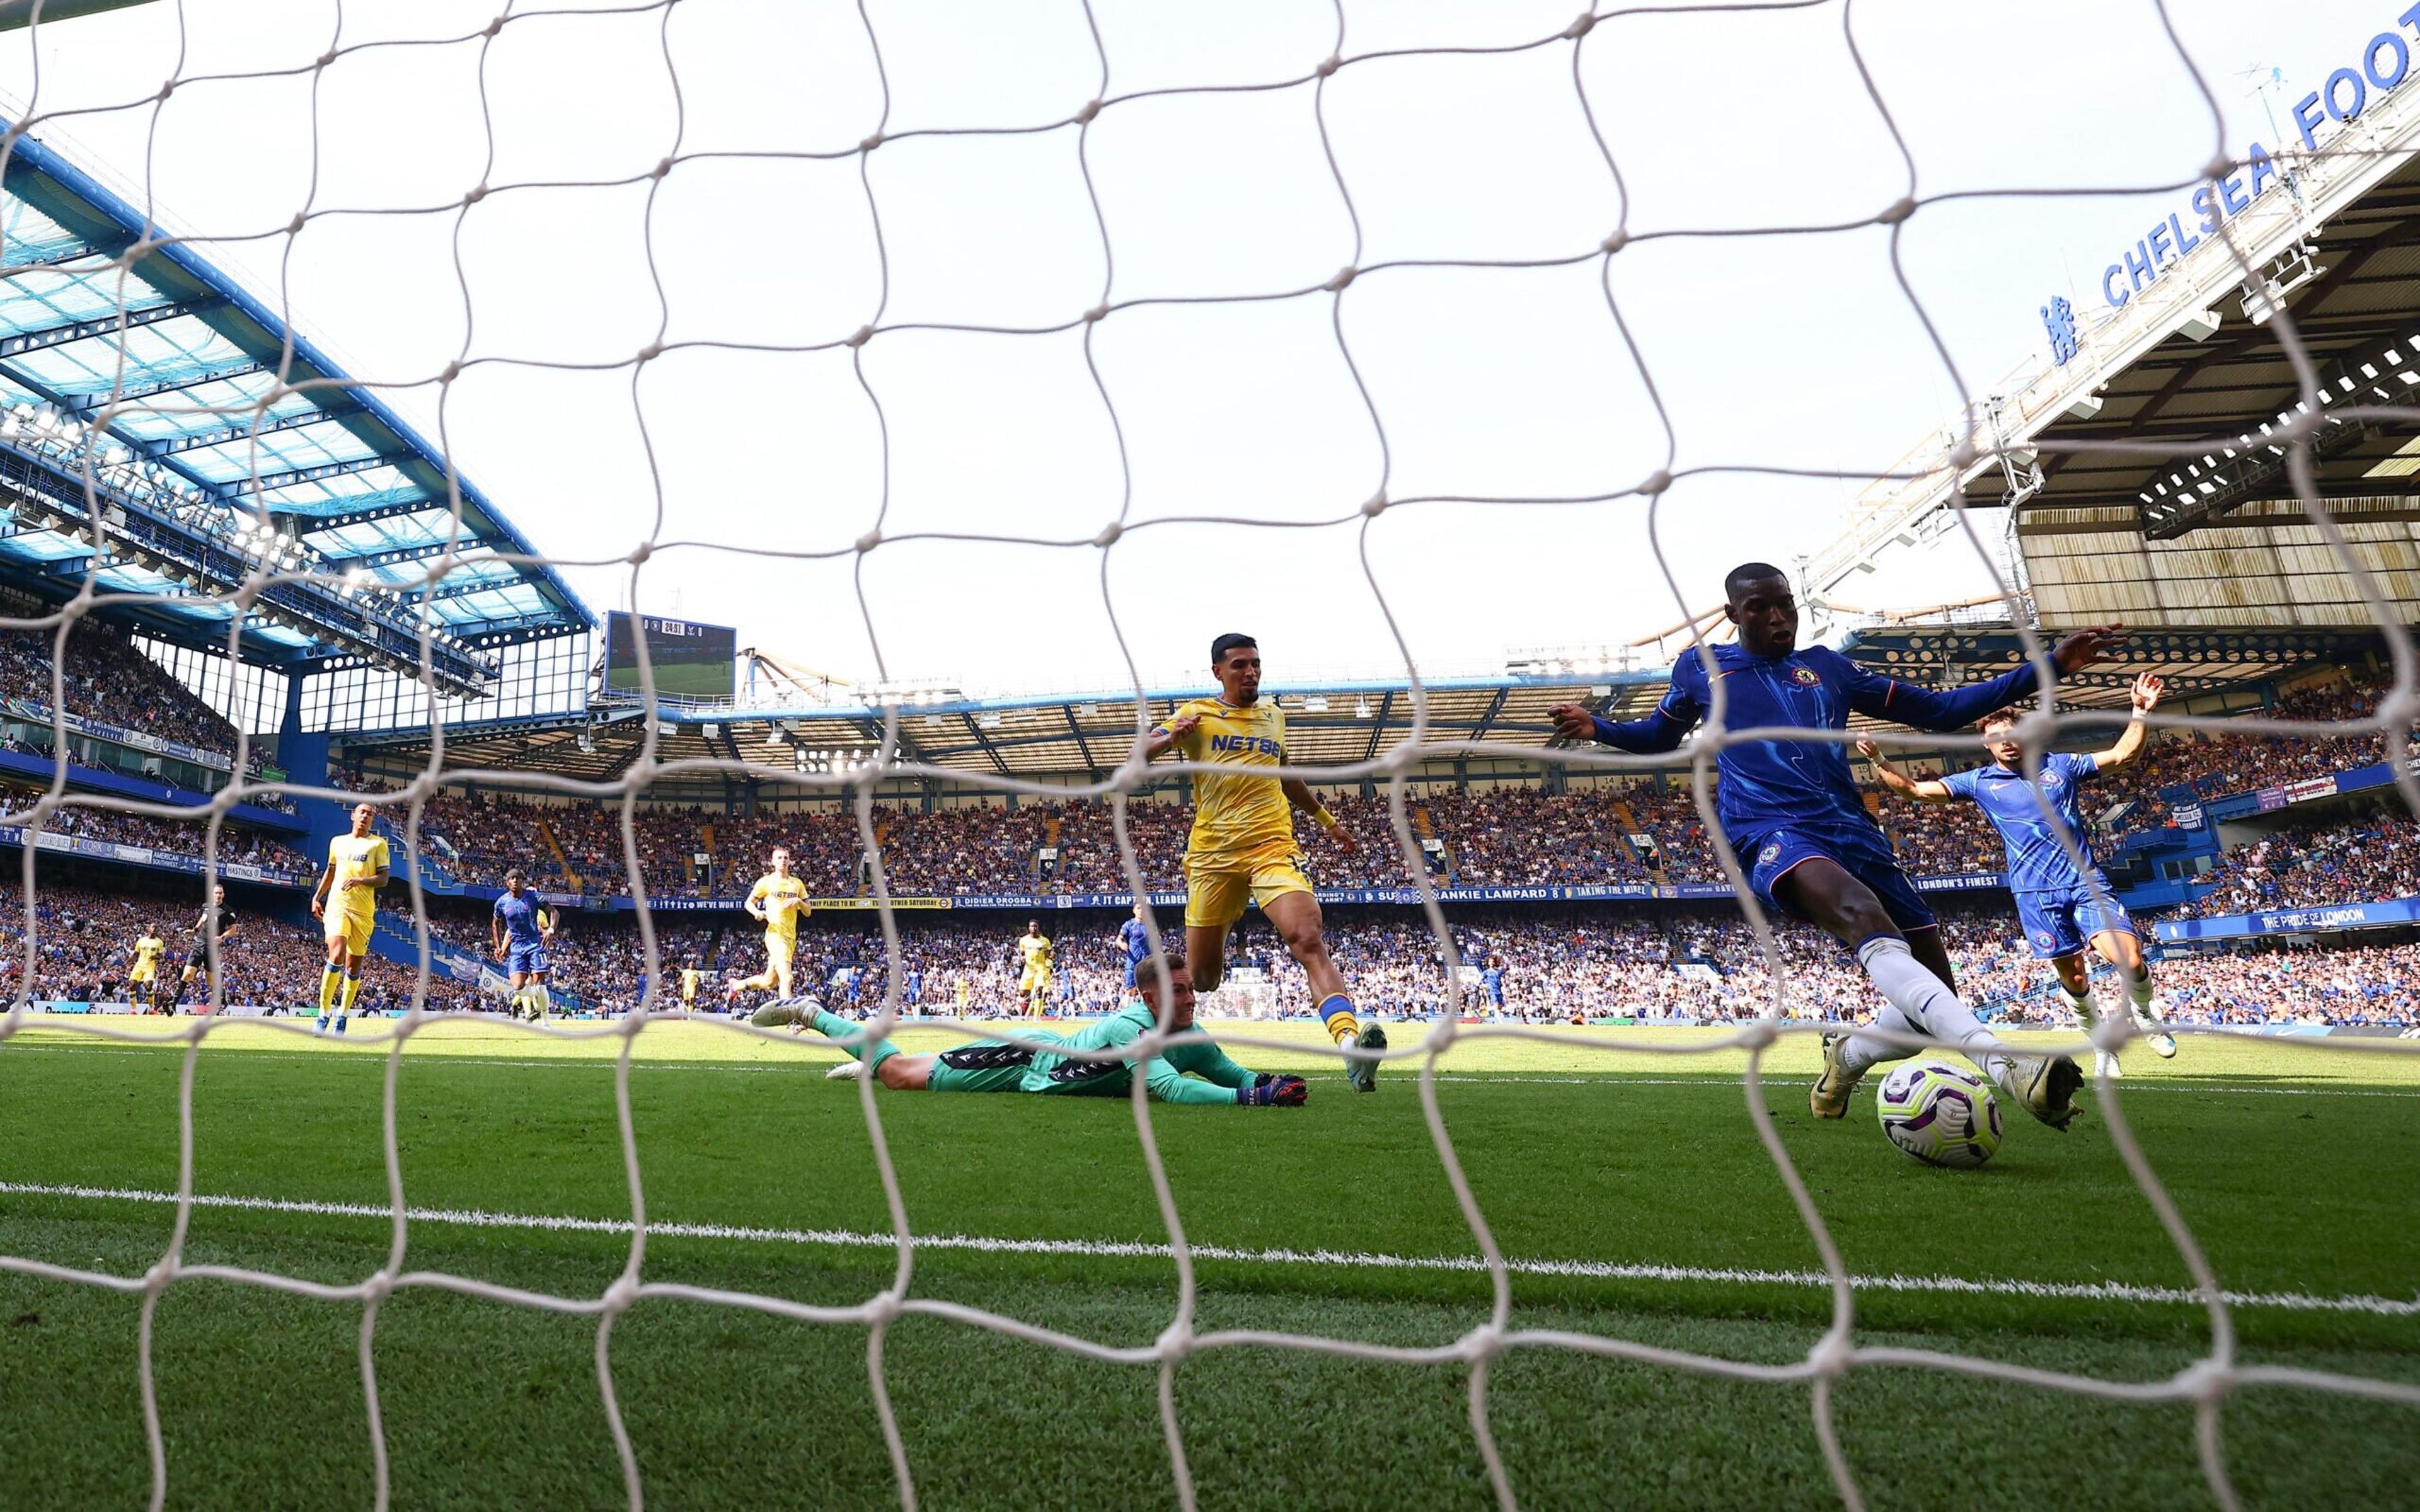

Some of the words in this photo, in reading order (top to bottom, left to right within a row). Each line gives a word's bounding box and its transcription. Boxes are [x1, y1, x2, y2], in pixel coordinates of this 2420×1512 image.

[2102, 142, 2277, 307] CHELSEA
[82, 839, 102, 852] CORK
[153, 851, 179, 861] AMERICAN
[228, 866, 253, 877] HASTINGS
[1917, 879, 1963, 889] LONDON'S
[1966, 876, 1998, 887] FINEST
[1485, 889, 1547, 899] LAMPARD
[1552, 890, 1559, 898] 8
[1576, 886, 1606, 896] TAKING
[1607, 886, 1622, 895] THE
[1103, 896, 1112, 905] JT
[1114, 895, 1155, 905] CAPTN,
[1155, 895, 1187, 905] LEADER
[2261, 918, 2280, 929] THE
[2281, 915, 2310, 927] PRIDE
[2310, 913, 2319, 921] OF
[2320, 908, 2366, 924] LONDON
[539, 953, 548, 963] 11
